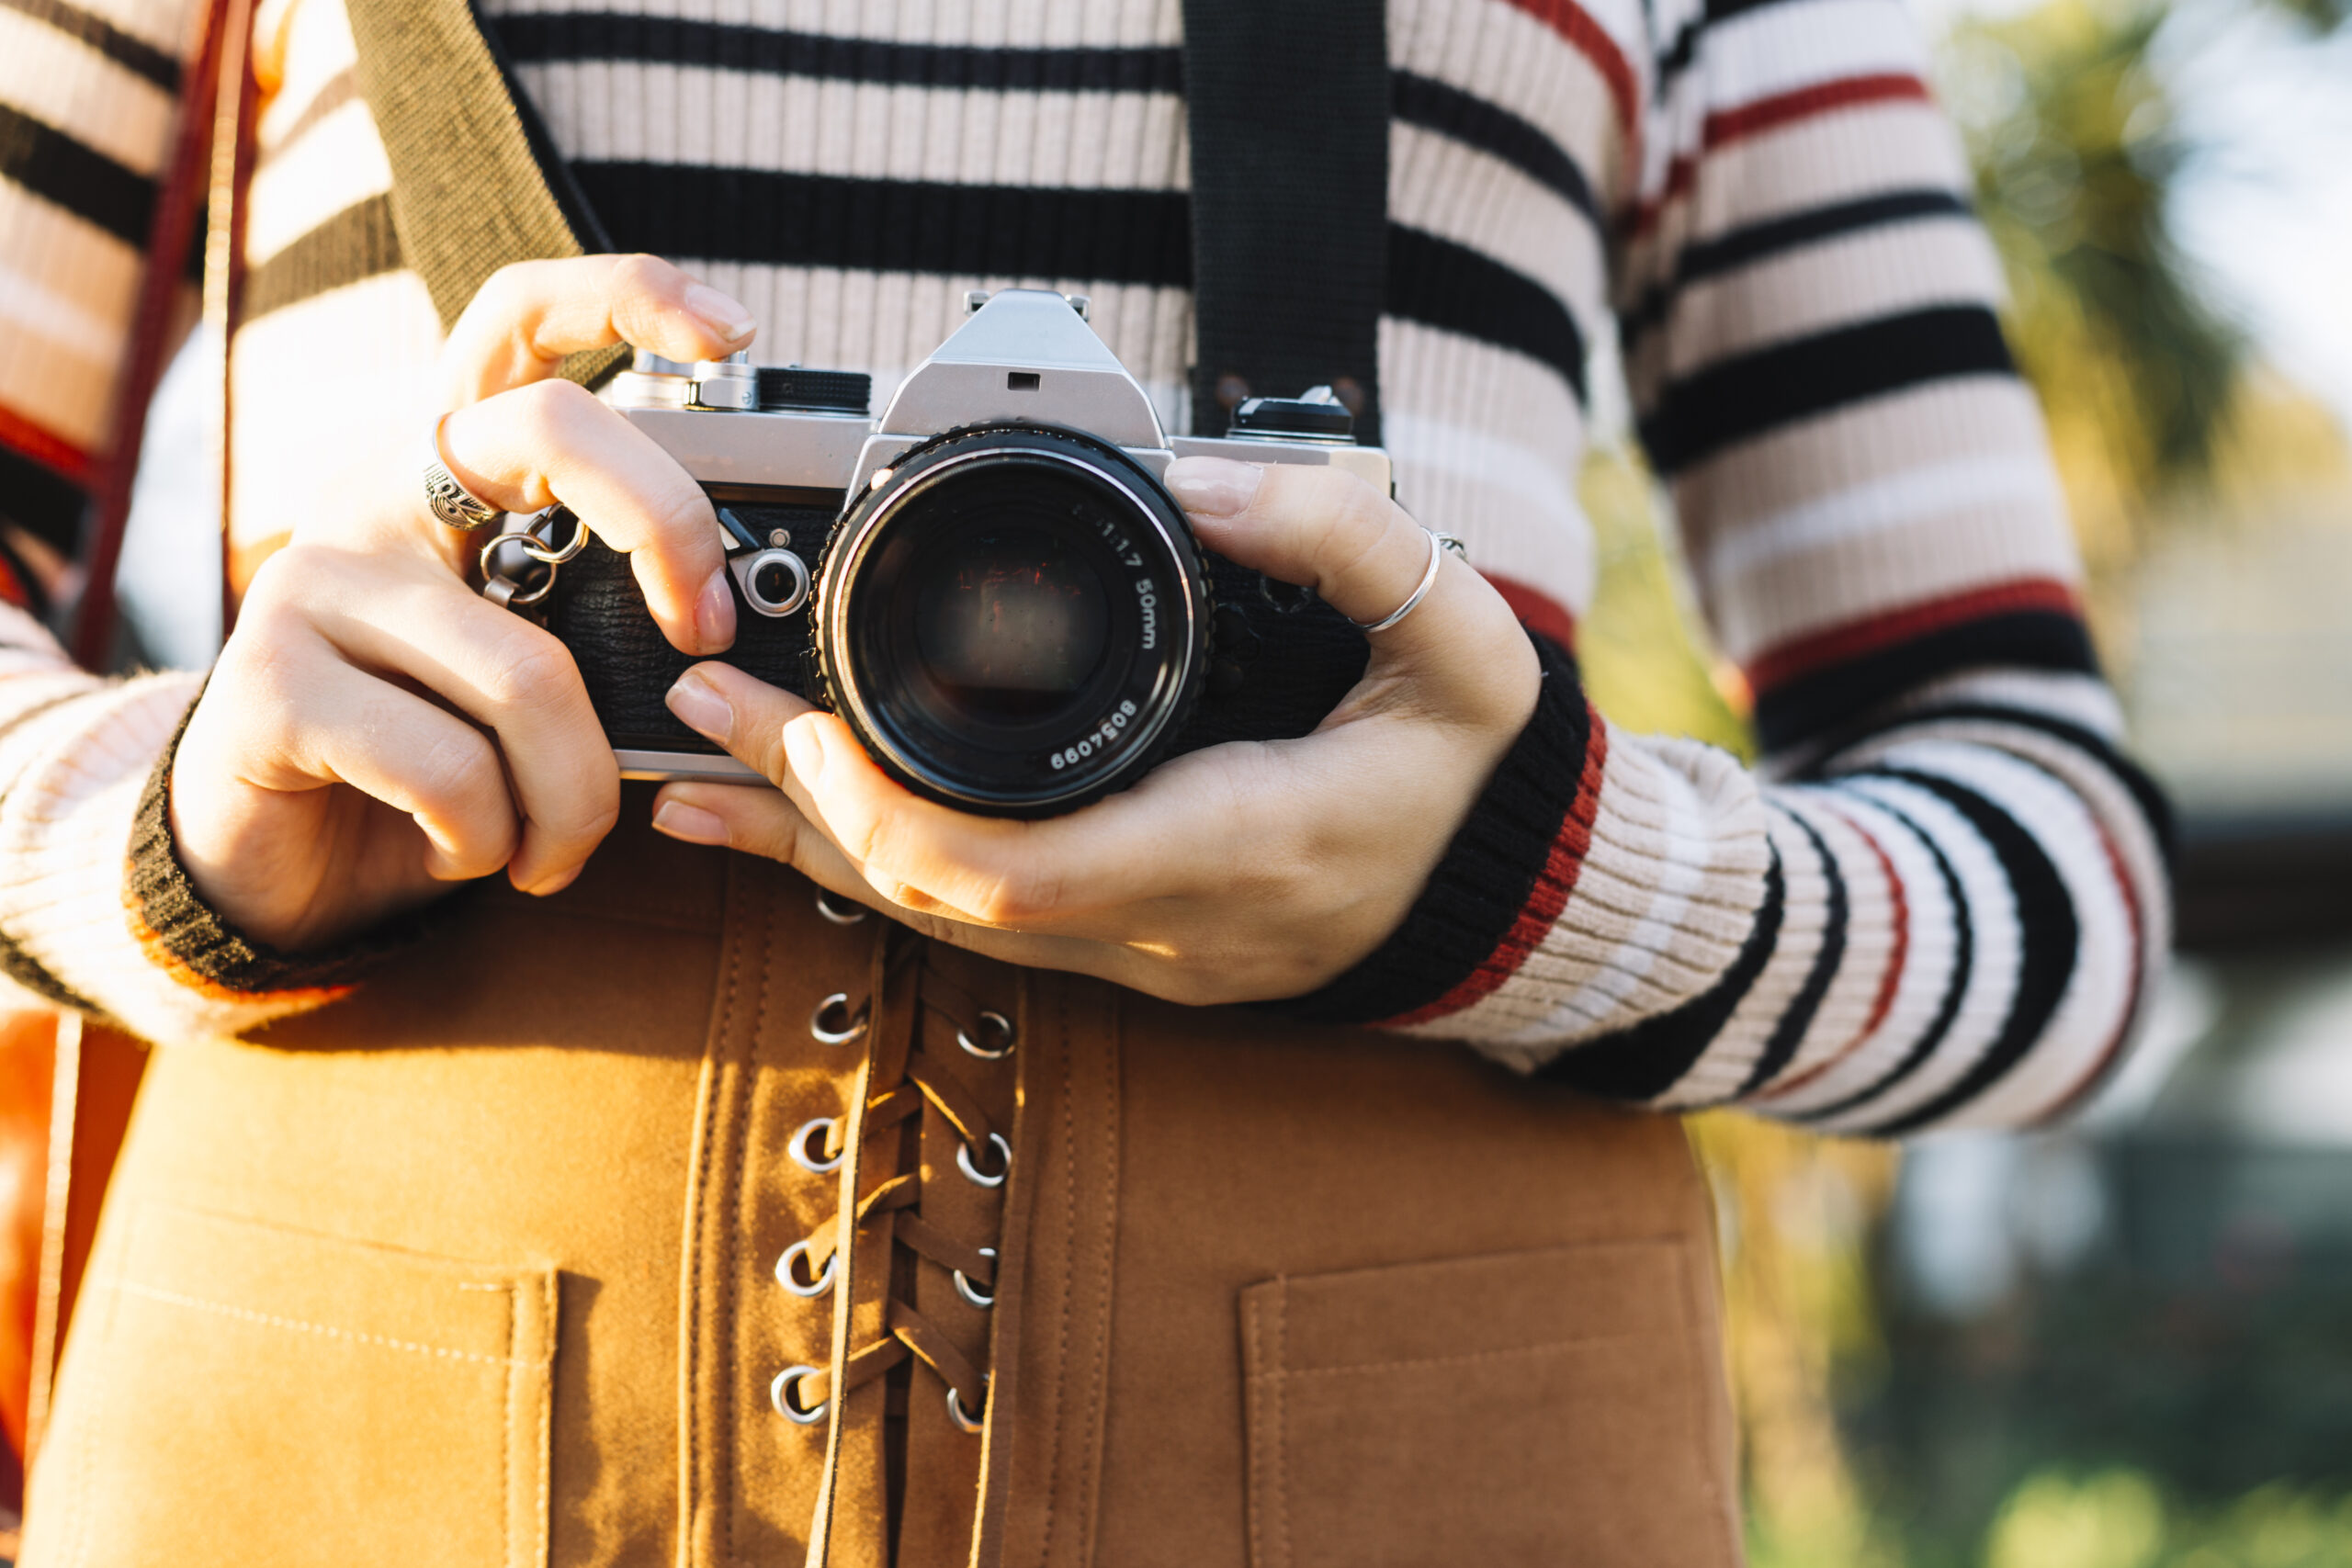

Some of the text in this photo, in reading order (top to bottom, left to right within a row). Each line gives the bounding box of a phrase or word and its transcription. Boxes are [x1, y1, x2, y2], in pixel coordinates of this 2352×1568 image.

[1102, 522, 1158, 650] 1:1.7 50mm
[1050, 699, 1137, 770] 8054099
